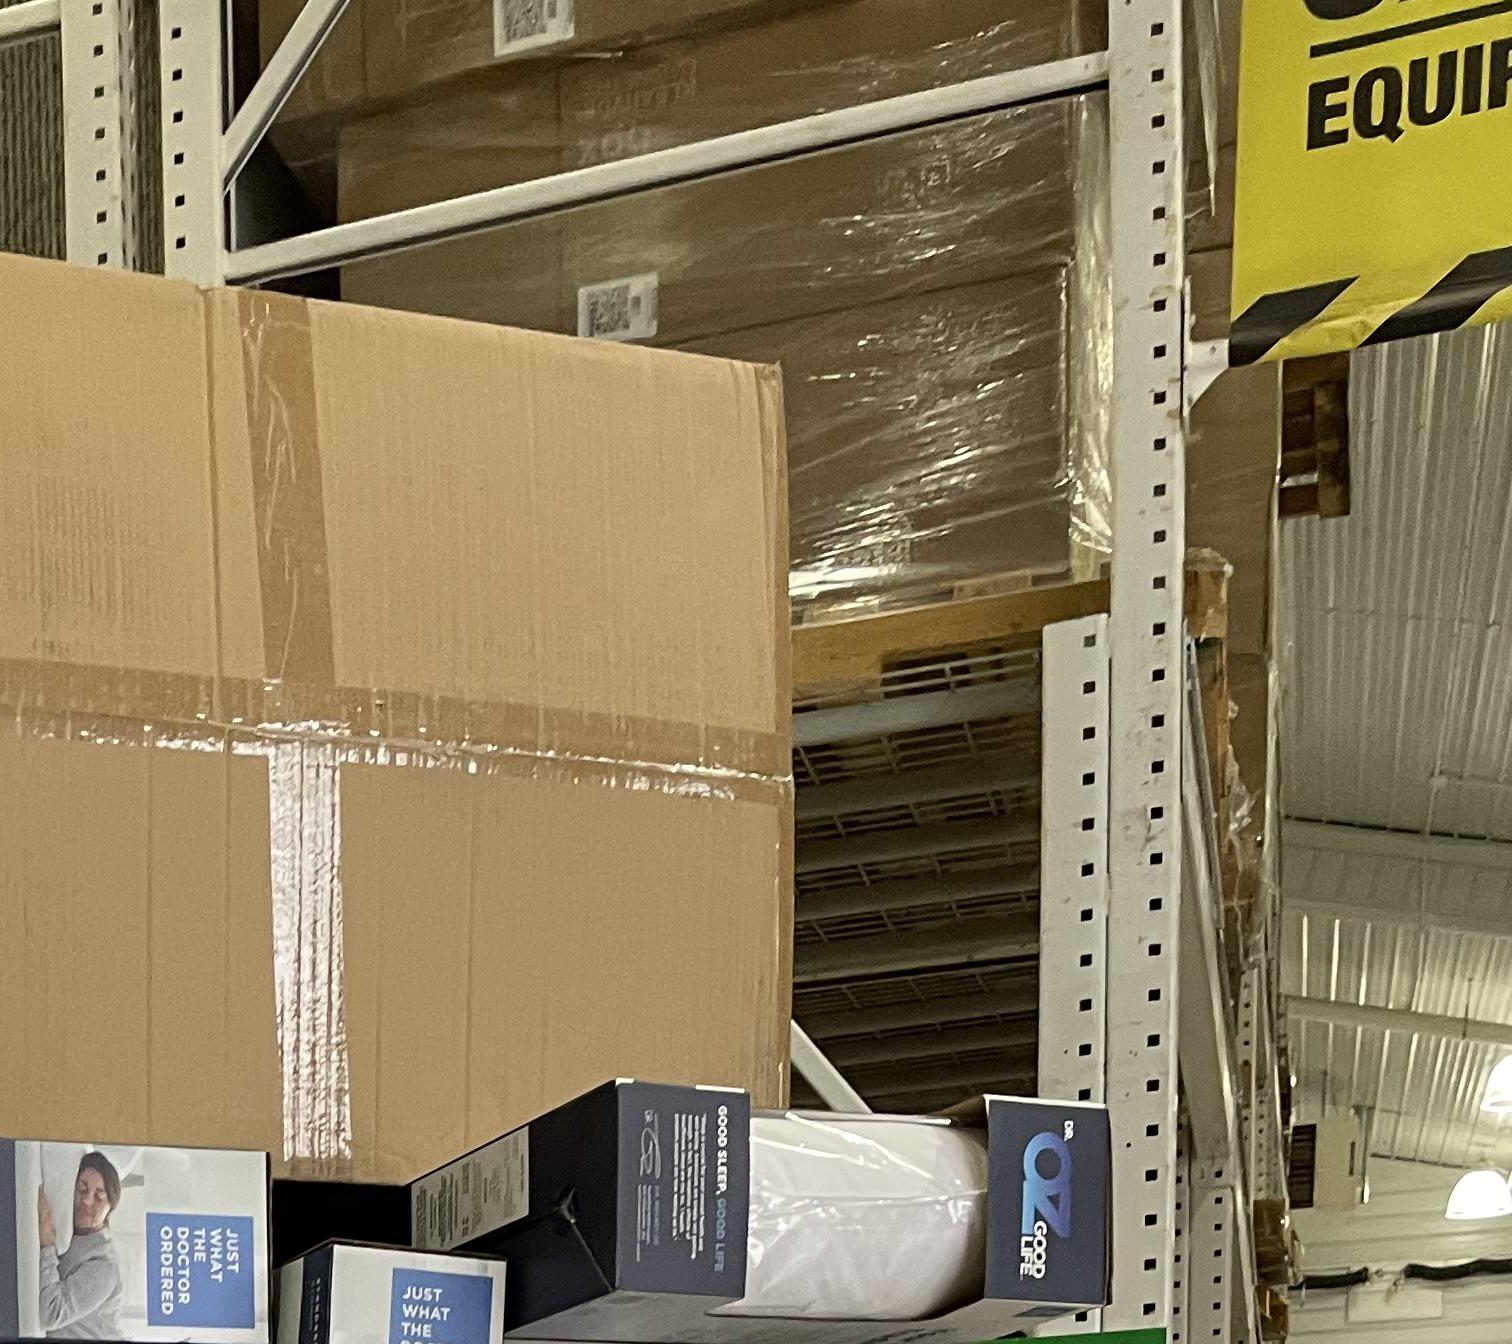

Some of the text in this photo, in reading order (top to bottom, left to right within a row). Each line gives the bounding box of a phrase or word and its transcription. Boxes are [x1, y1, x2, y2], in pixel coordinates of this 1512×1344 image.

[193, 1227, 207, 1262] THE
[210, 1228, 223, 1282] WHAT
[226, 1228, 240, 1273] JUST
[160, 1225, 174, 1315] ORDERED
[177, 1227, 191, 1304] DOCTOR
[402, 1285, 443, 1302] JUST
[402, 1303, 451, 1321] WHAT
[401, 1321, 432, 1338] THE
